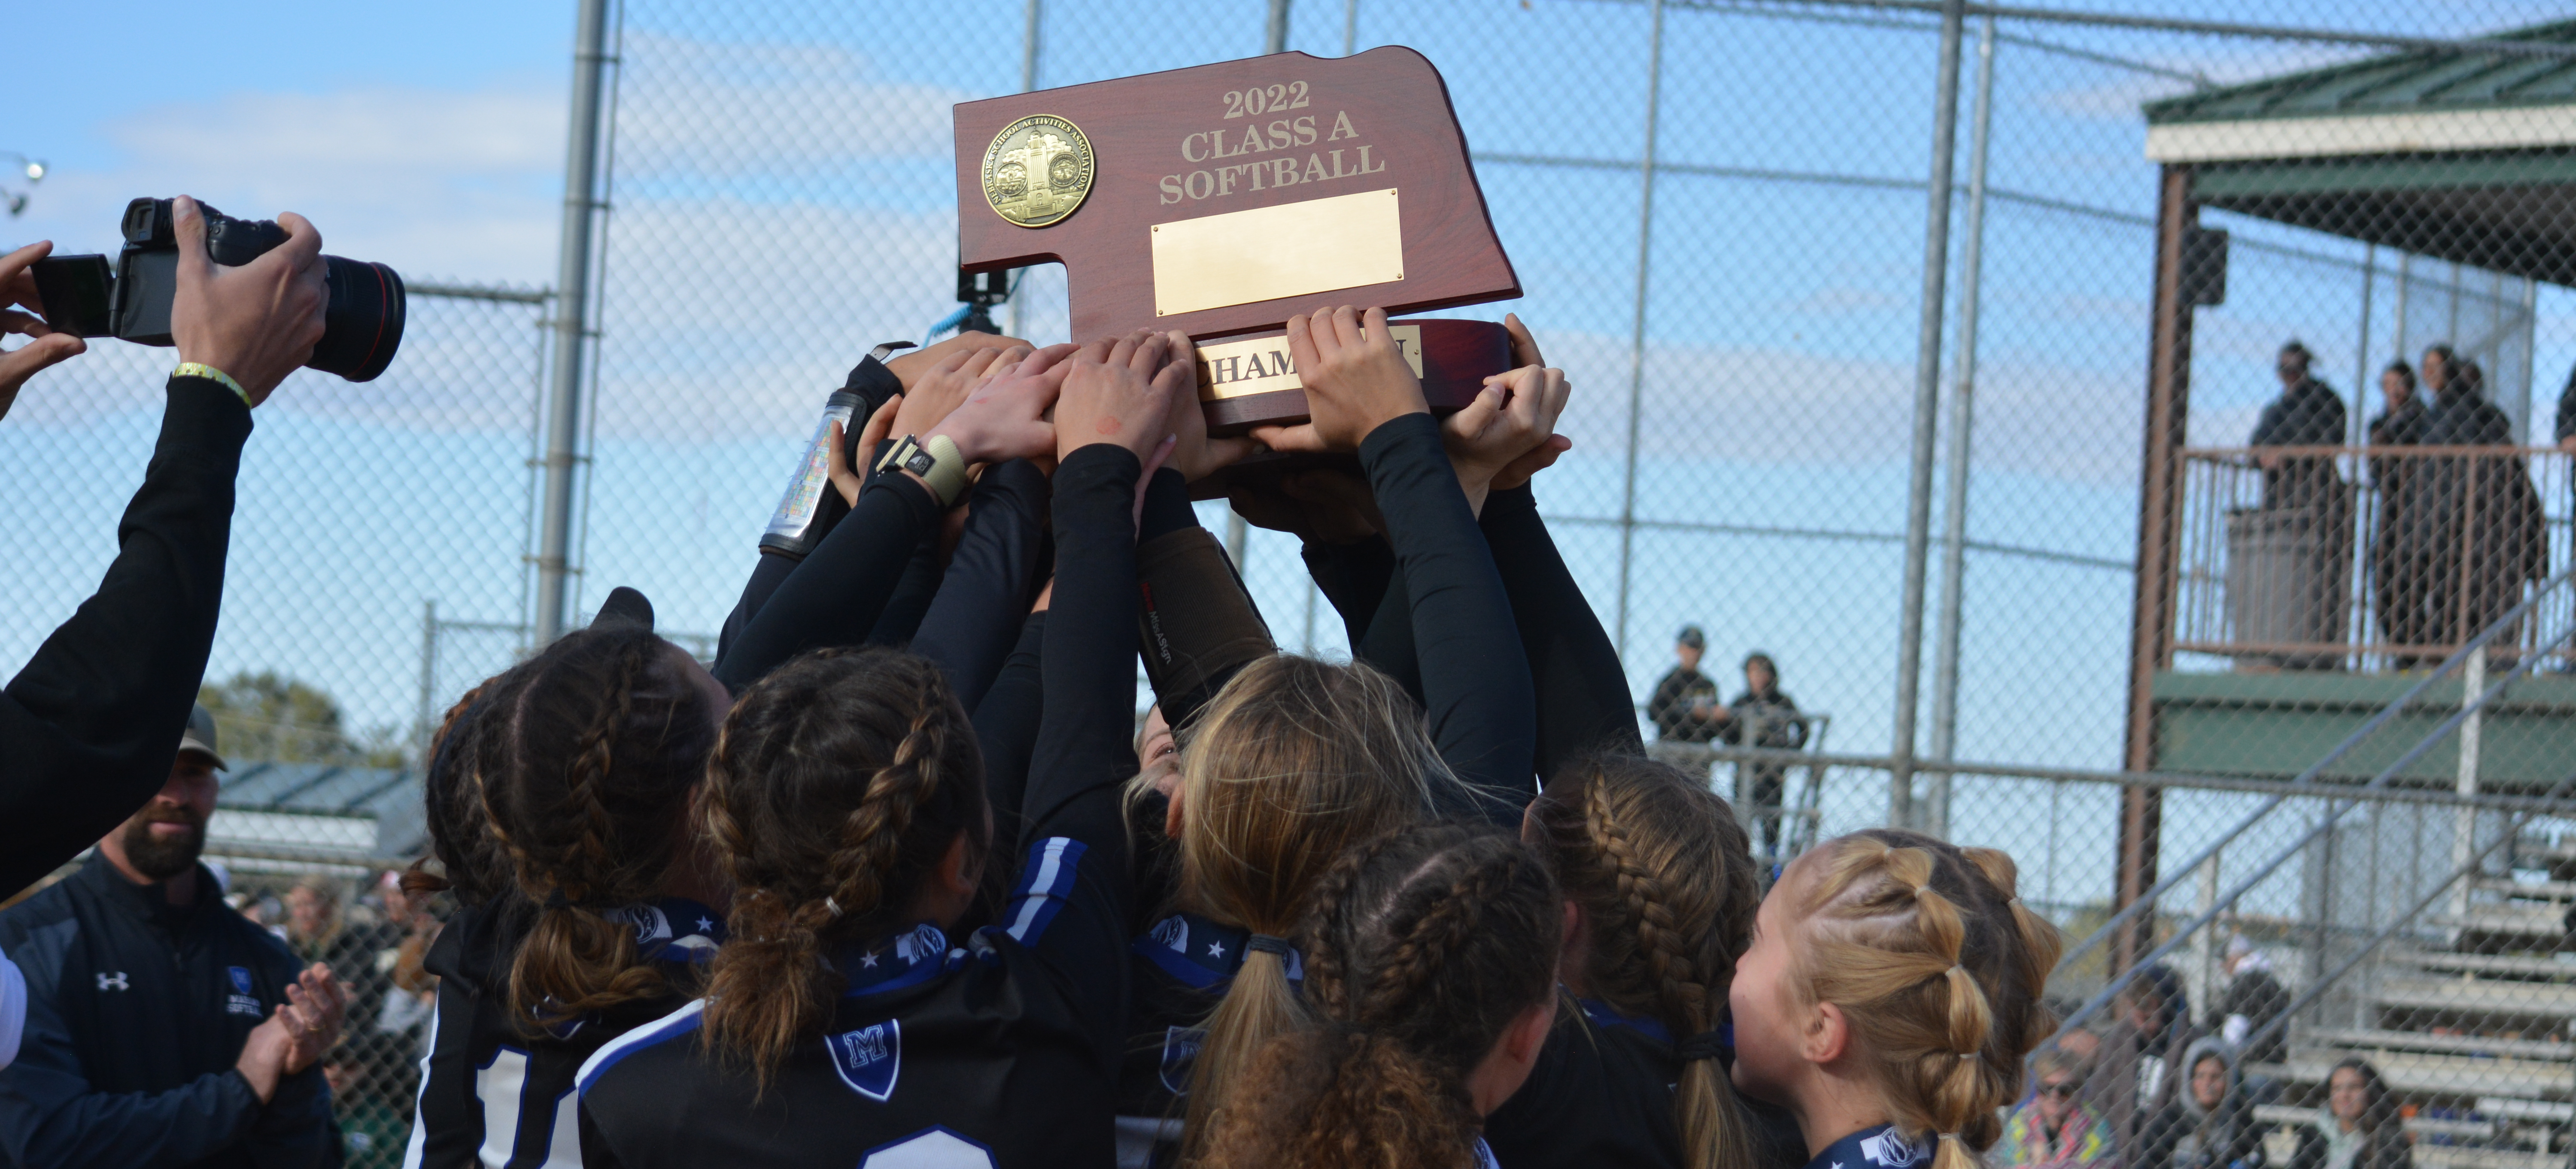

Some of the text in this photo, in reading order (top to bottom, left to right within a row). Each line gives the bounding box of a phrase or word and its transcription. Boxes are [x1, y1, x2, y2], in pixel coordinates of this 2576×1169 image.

[1223, 80, 1309, 119] 2022
[992, 124, 1022, 155] SCHOOL
[1022, 118, 1072, 133] ACTIVITIES
[1182, 110, 1359, 163] CLASS A
[985, 156, 1002, 204] NEBRASKA
[1070, 131, 1090, 190] ASSOCIATION
[1159, 145, 1385, 205] SOFTBALL
[919, 458, 930, 471] CLIP
[843, 1024, 888, 1068] M
